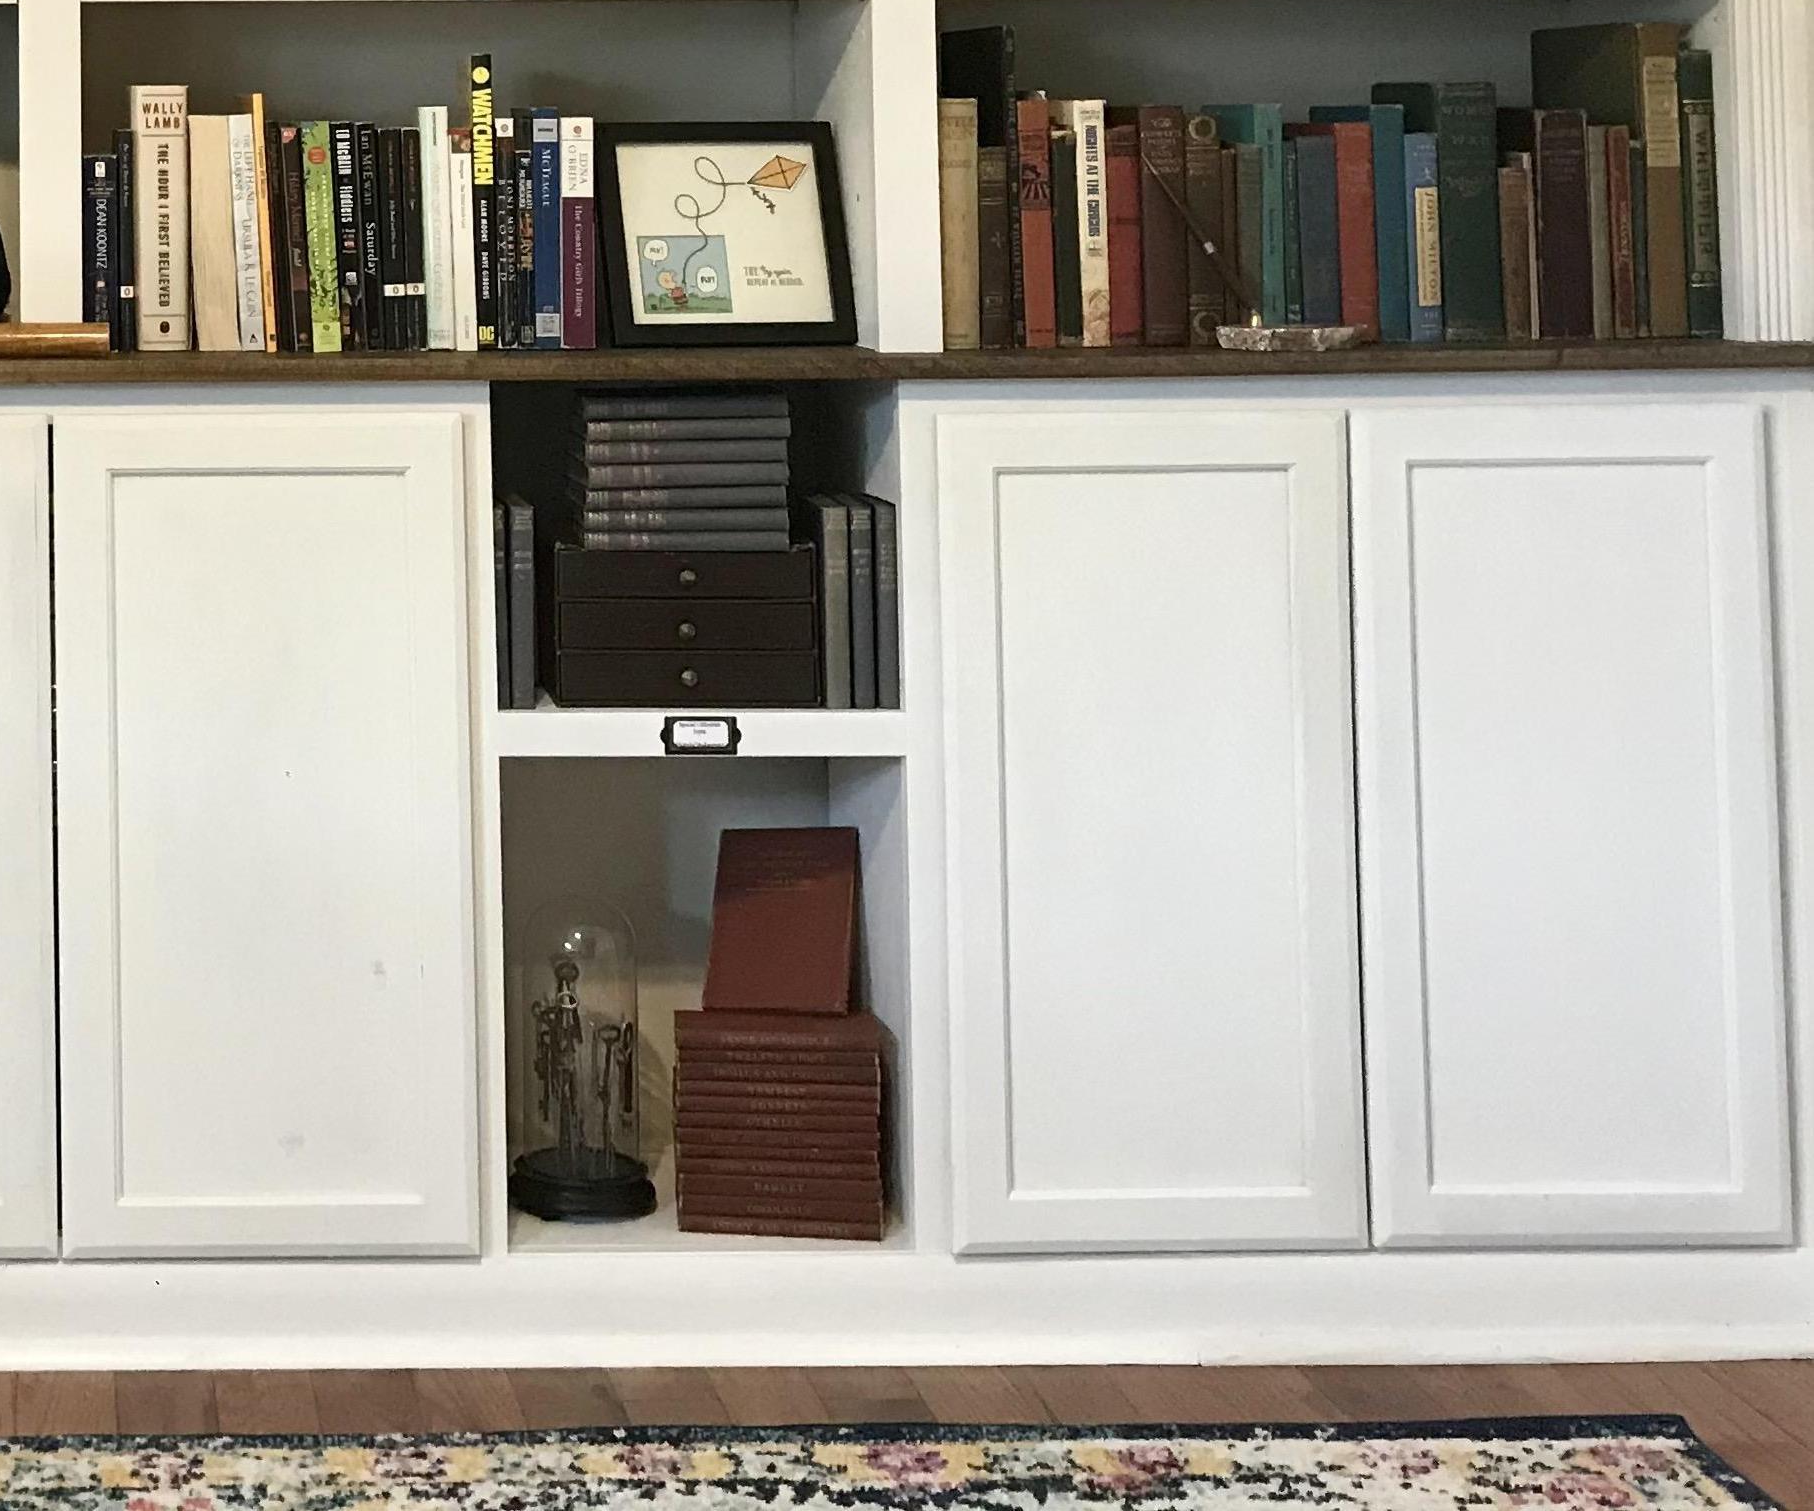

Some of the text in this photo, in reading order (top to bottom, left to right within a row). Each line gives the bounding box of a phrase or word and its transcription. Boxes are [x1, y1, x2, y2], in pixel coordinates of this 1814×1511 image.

[142, 103, 184, 114] WALLY
[145, 117, 181, 129] LAMB
[157, 143, 169, 165] THE
[472, 88, 493, 185] WATCHMEN
[158, 170, 169, 200] HOUR
[568, 145, 578, 191] O'BRIEN
[1086, 125, 1100, 237] NIGHTS AT THE CIRCUS
[1696, 128, 1711, 255] WHITTIER
[96, 199, 107, 269] DEAN KOONTZ
[158, 214, 170, 247] FIRST
[365, 222, 378, 275] Saturday
[1425, 191, 1439, 300] JOHN MILTON
[158, 252, 170, 307] BELIEVED
